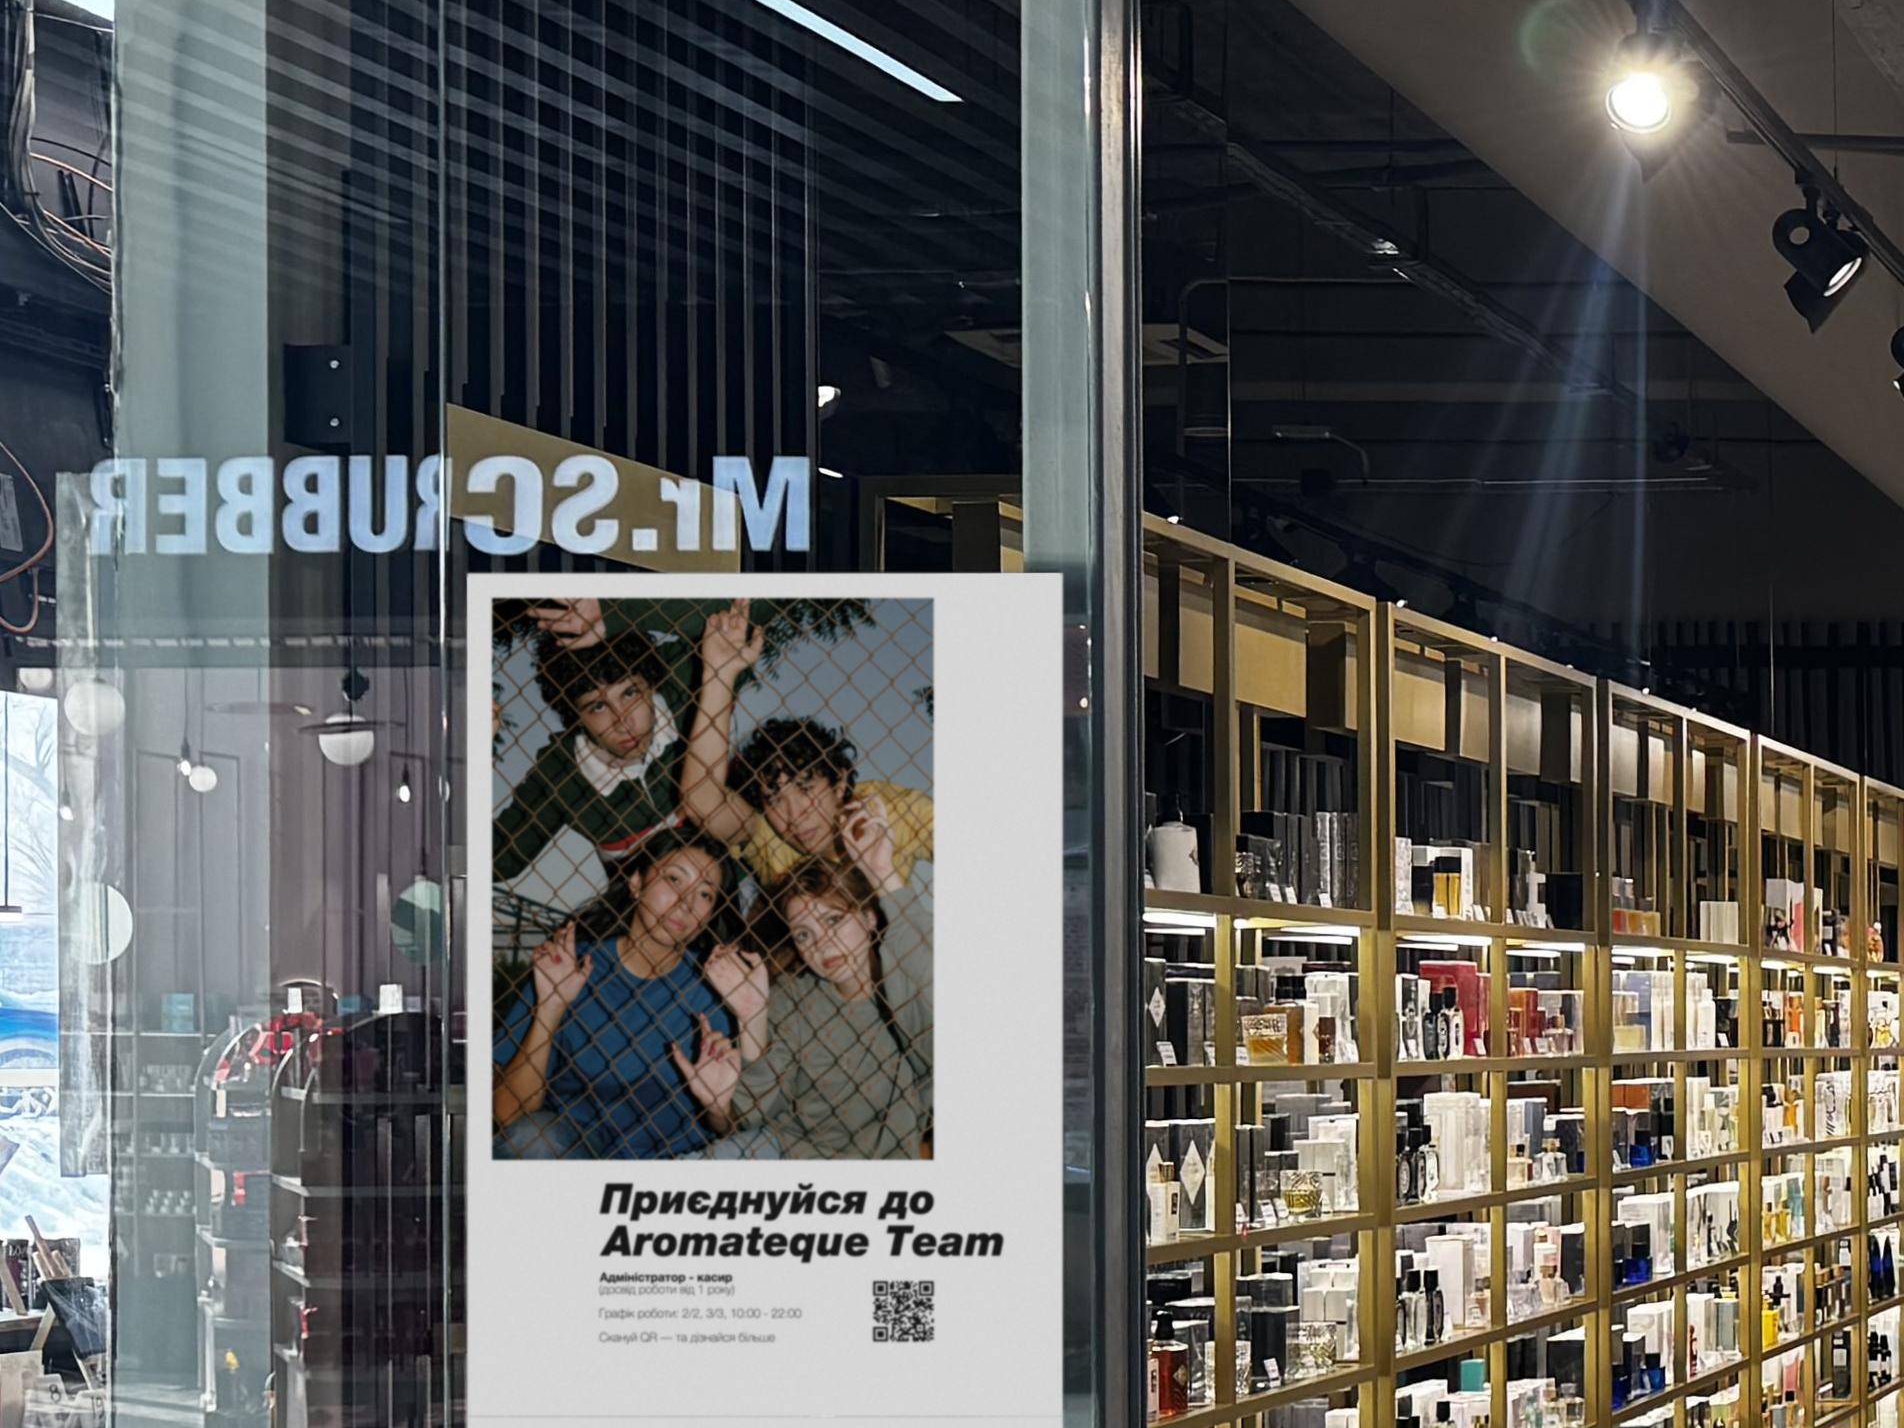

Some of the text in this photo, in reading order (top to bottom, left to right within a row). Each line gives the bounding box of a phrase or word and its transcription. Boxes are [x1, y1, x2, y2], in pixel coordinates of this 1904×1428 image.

[599, 1182, 935, 1222] Приєднуйся до
[599, 1224, 1005, 1264] Aromateque Team
[599, 1271, 687, 1285] Адміністратор
[696, 1273, 734, 1285] касир
